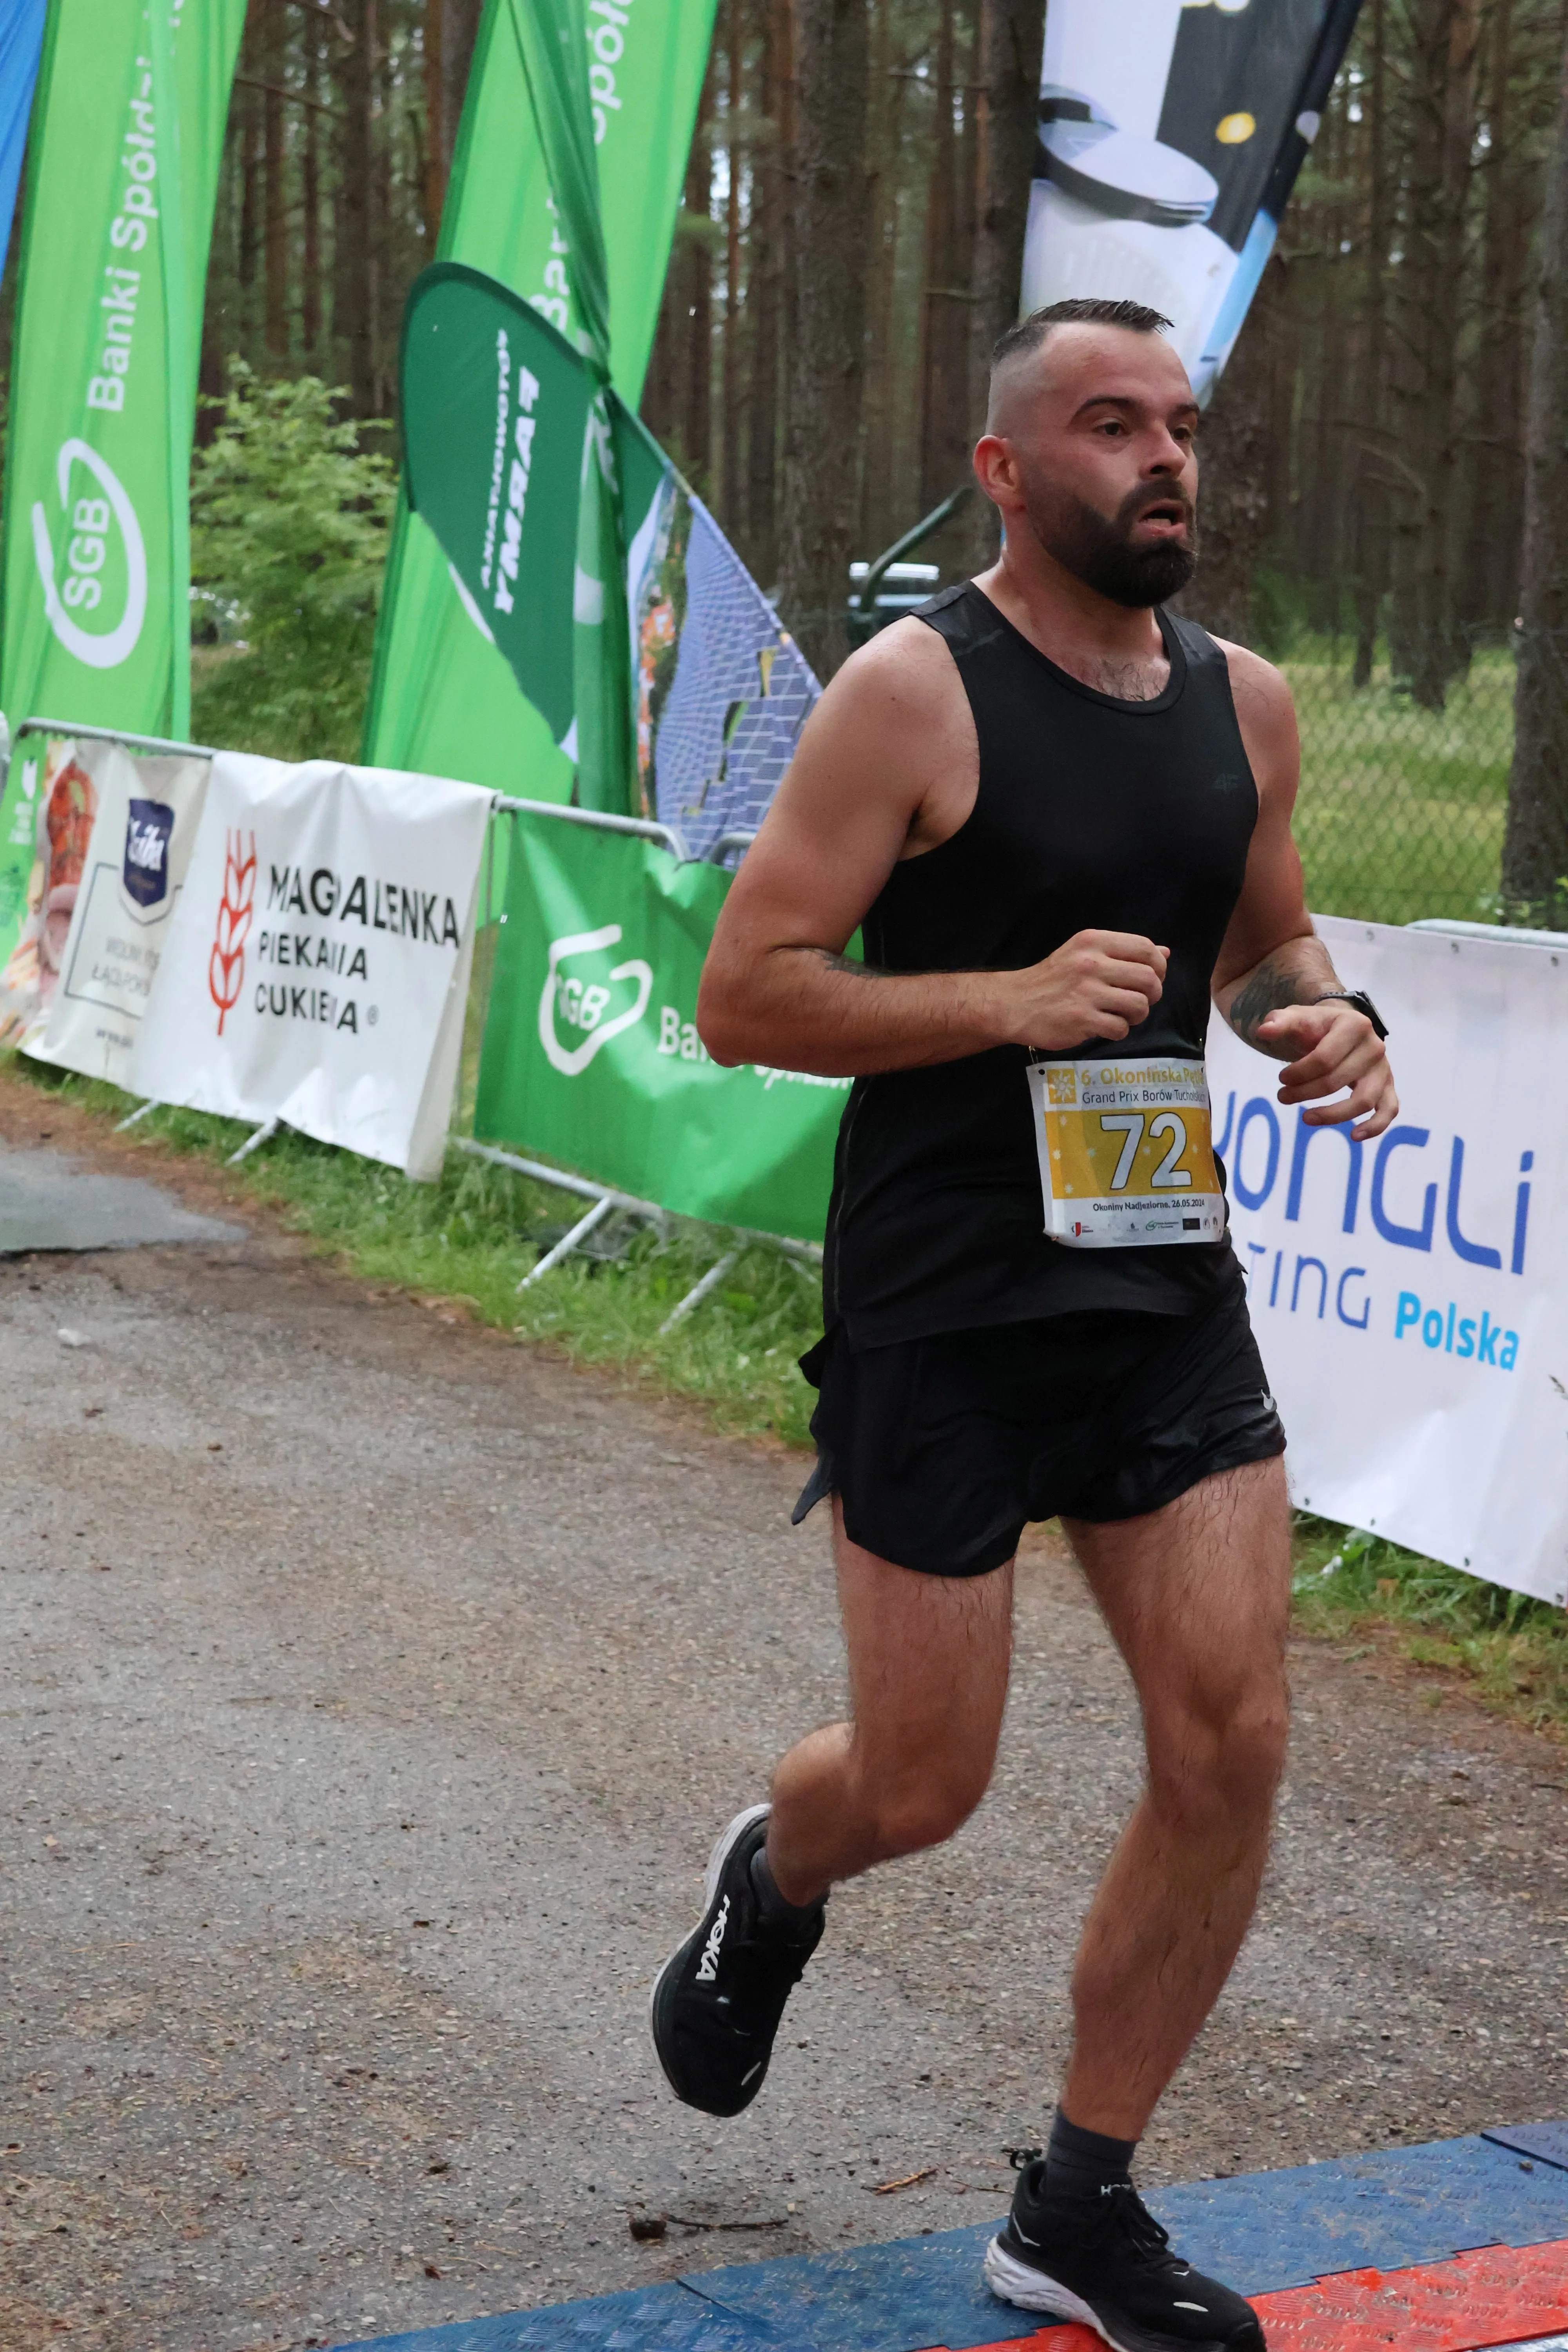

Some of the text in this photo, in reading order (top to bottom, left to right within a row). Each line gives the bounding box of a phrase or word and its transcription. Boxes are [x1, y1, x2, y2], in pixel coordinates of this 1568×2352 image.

[87, 267, 140, 412] Banki
[64, 497, 110, 610] SGB
[1081, 1069, 1096, 1086] 6.
[1082, 1091, 1115, 1104] Grand
[1119, 1090, 1139, 1102] Prix
[1143, 1089, 1172, 1102] Borów
[1100, 1111, 1192, 1190] 72
[1093, 1203, 1123, 1212] Okoniny
[1171, 1199, 1205, 1208] 26.05.2024
[1394, 1291, 1520, 1372] Polska
[695, 1894, 731, 1981] HOKA
